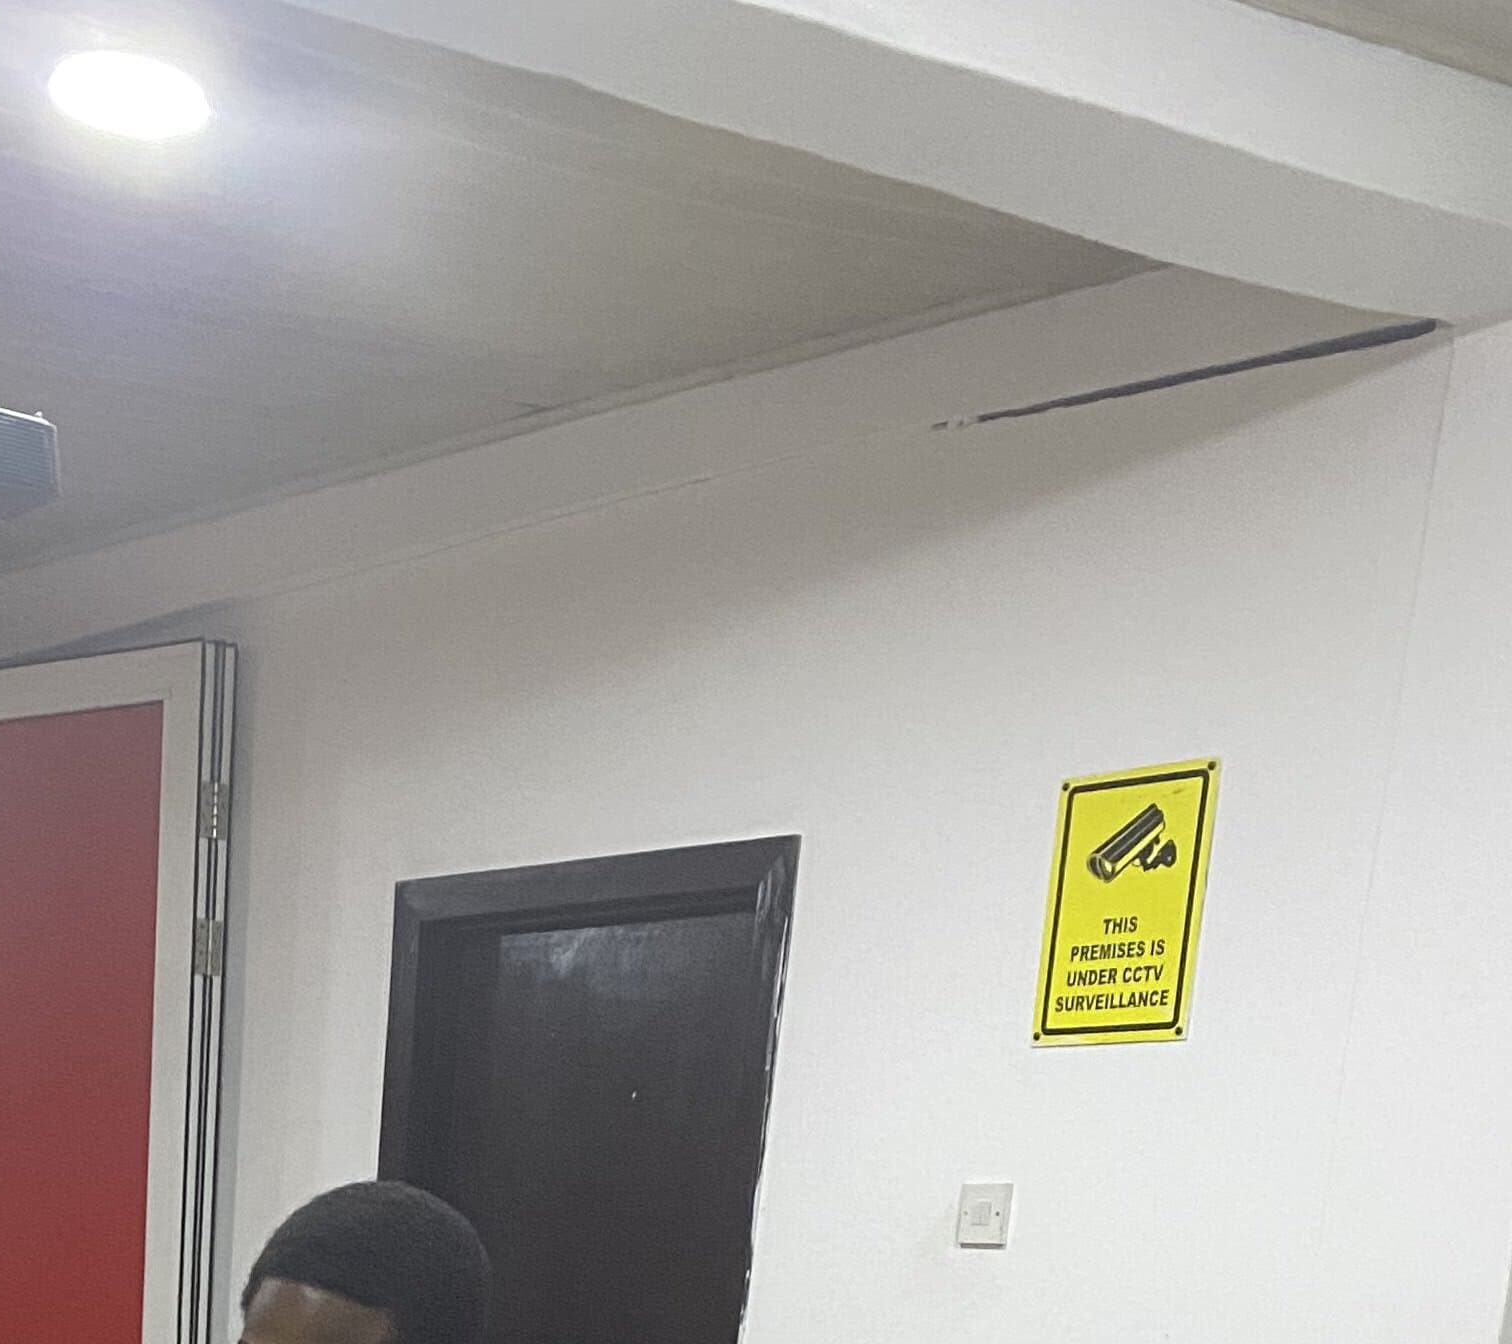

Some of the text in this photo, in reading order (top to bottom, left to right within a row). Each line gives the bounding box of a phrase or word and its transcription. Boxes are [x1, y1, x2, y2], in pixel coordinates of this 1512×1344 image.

[1103, 916, 1138, 935] THIS
[1070, 939, 1165, 962] PREMISES IS
[1066, 964, 1164, 987] UNDER CCTV
[1054, 990, 1169, 1013] SURVEILLANCE
